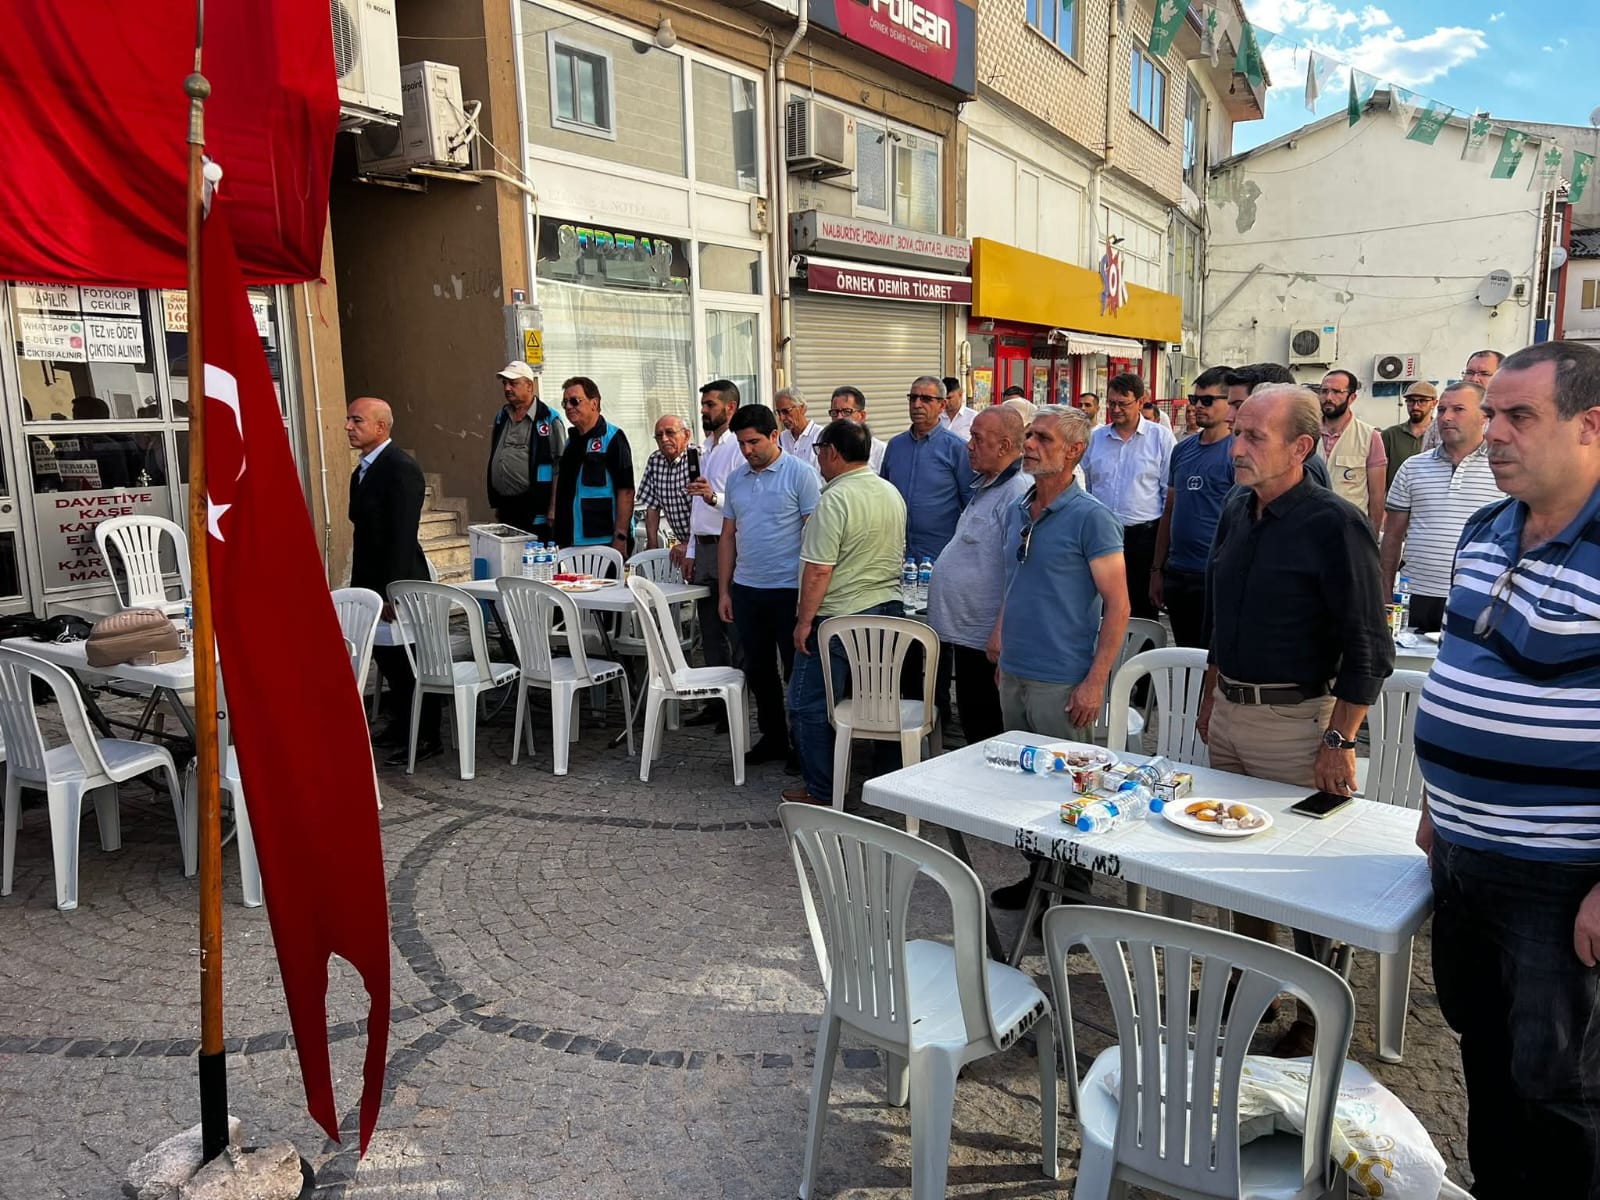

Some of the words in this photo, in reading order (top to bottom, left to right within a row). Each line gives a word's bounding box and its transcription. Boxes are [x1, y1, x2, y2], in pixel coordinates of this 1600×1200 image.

[836, 271, 876, 293] ÖRNEK
[878, 278, 910, 297] DEMİR
[912, 280, 952, 299] TİCARET
[83, 287, 137, 301] FOTOKOPİ
[90, 299, 132, 312] ÇEKİLİR
[23, 321, 69, 333] WHATSAPP
[90, 323, 105, 339] TEZ
[116, 321, 138, 341] ÖDEV
[56, 349, 83, 360] ALINIR
[89, 342, 117, 358] ÇIKTISI
[117, 344, 144, 359] ALINIR
[55, 493, 153, 509] DAVETİYE
[79, 506, 134, 519] KAŞE
[59, 521, 99, 534] KAT
[71, 545, 99, 557] TA
